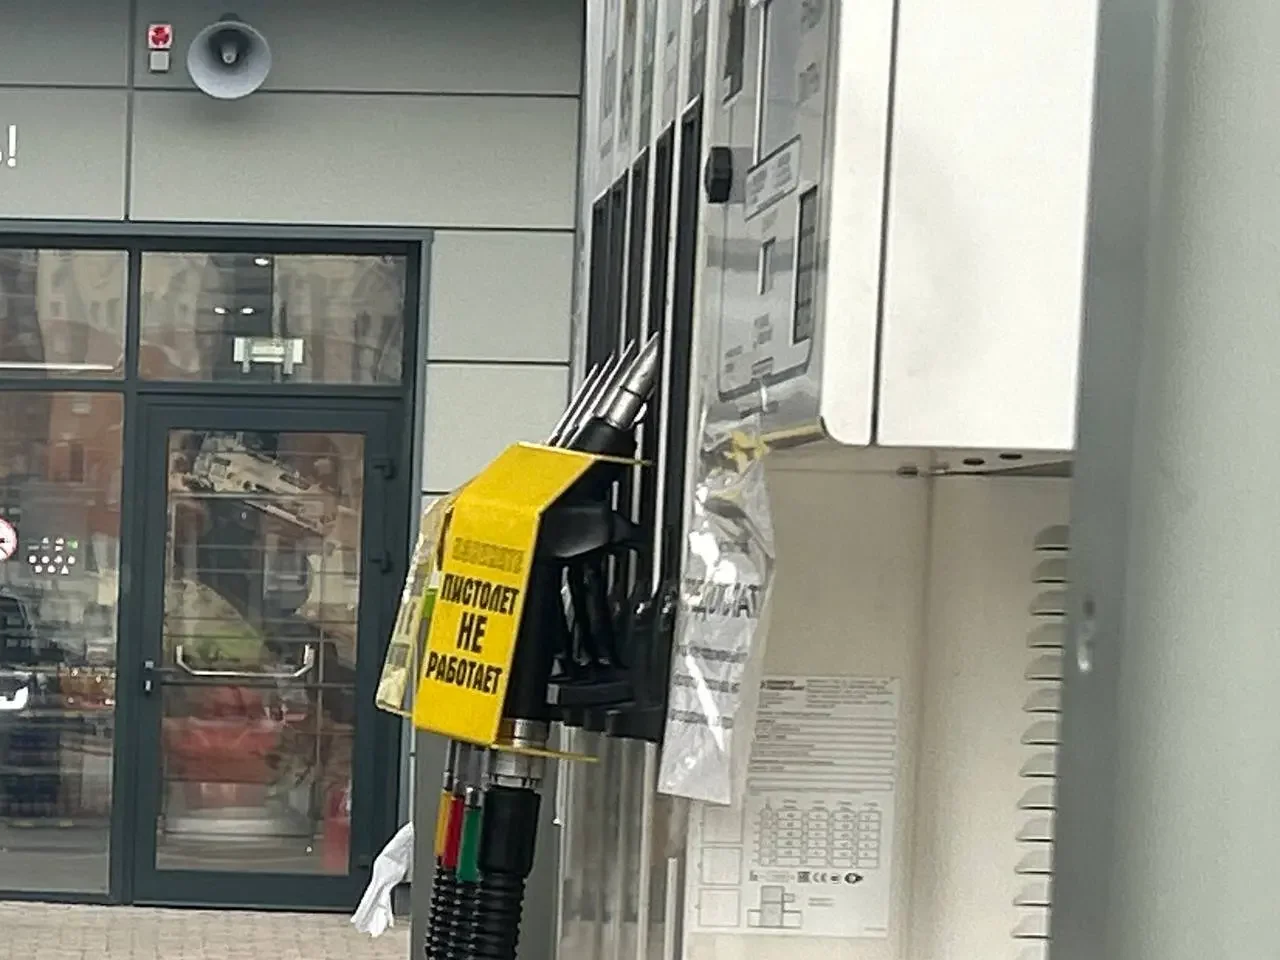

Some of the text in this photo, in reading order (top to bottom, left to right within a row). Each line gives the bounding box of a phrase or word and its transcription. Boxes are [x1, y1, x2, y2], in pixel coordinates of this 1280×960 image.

[440, 573, 520, 616] ПИСТОЛЕТ
[456, 611, 488, 653] НЕ
[425, 650, 503, 694] РАБОТАЕТ
